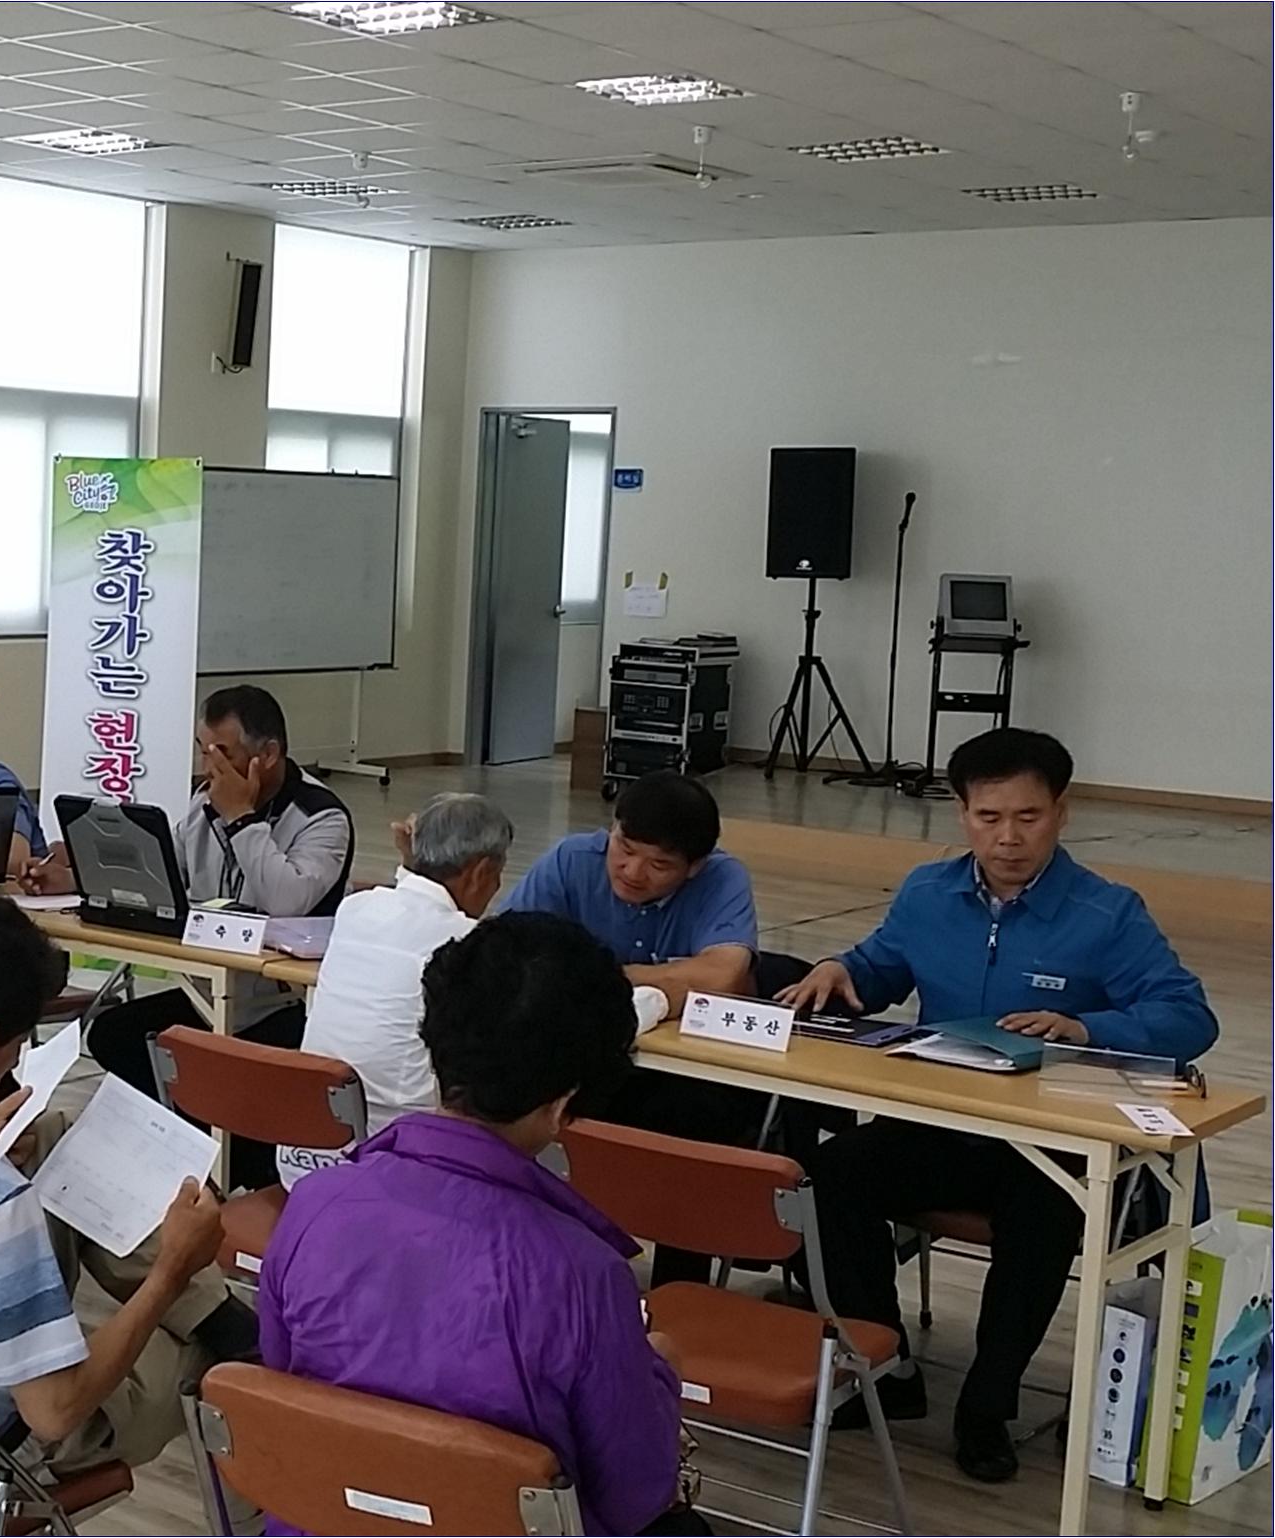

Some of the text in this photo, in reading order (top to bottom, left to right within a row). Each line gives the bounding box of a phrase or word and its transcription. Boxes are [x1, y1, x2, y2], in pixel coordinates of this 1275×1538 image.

[67, 474, 99, 491] Blue
[73, 485, 101, 505] City
[84, 530, 153, 805] 찾아가는 현장
[721, 1012, 780, 1036] 부동산
